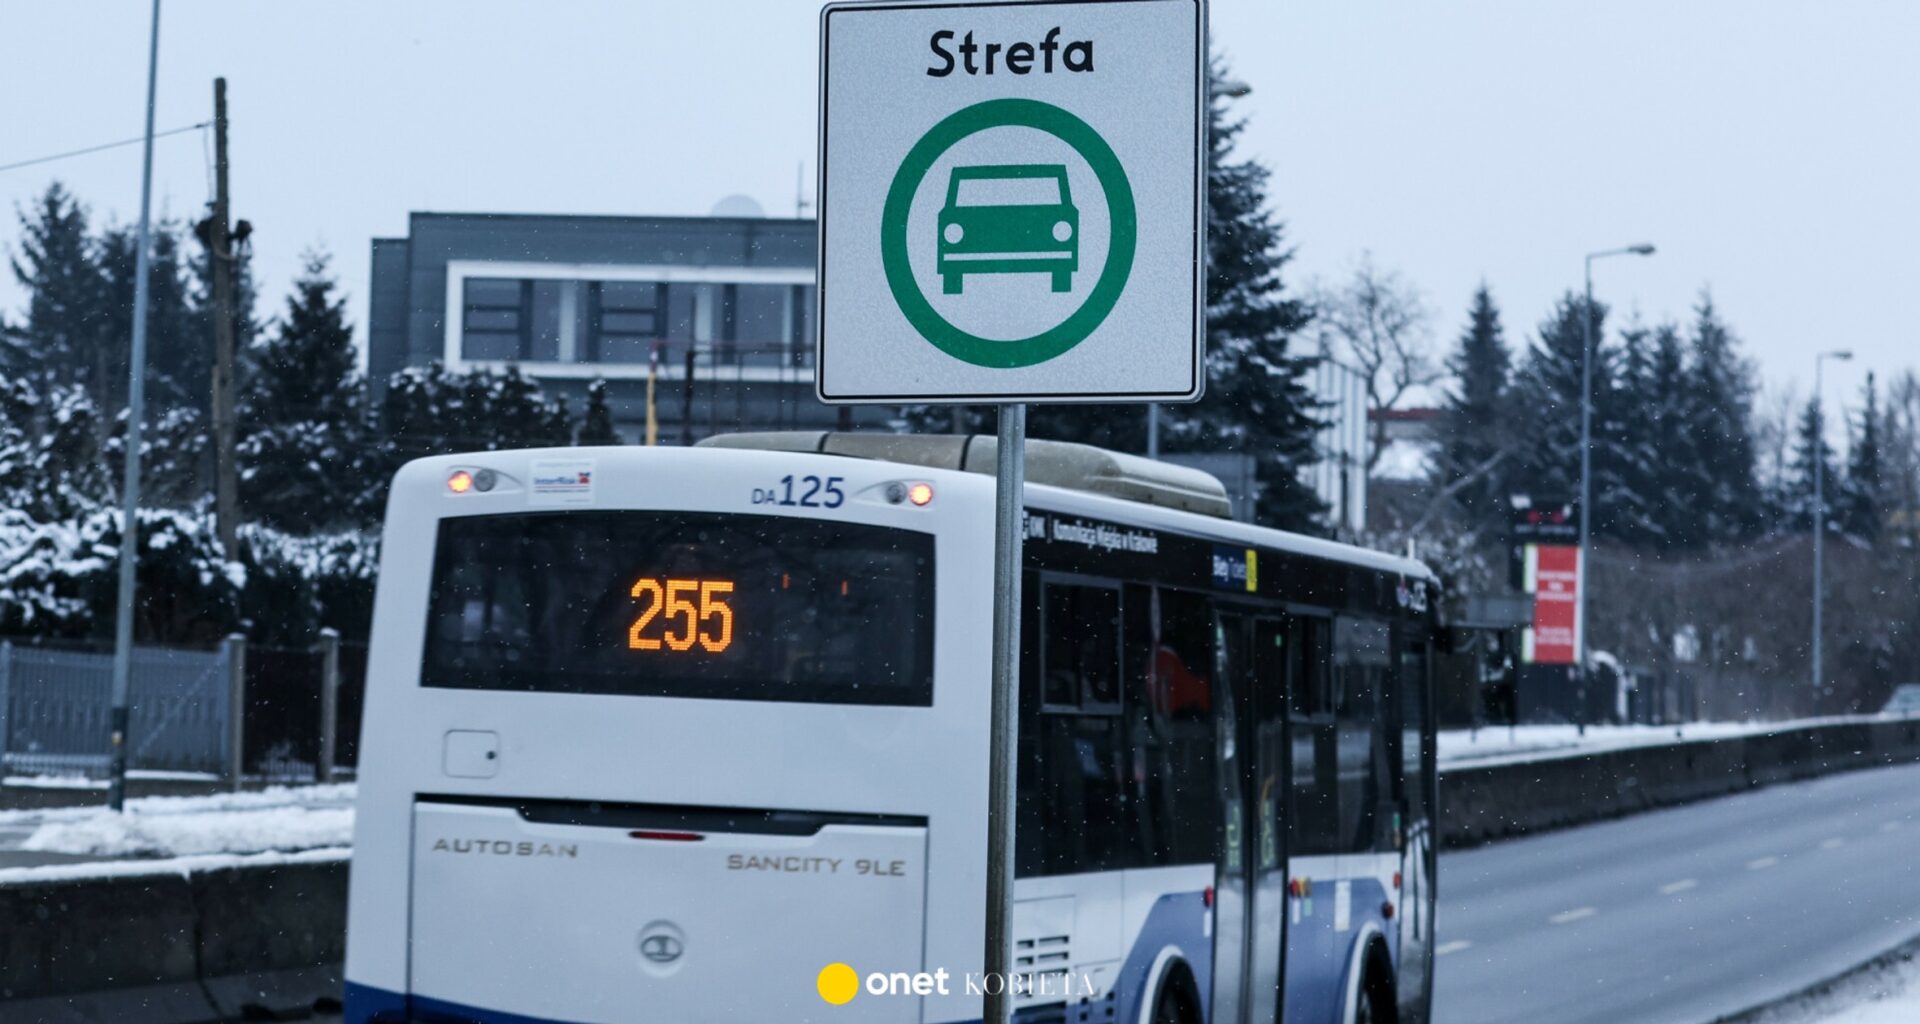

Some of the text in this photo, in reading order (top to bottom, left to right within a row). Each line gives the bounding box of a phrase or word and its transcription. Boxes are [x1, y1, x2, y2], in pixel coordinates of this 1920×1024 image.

[926, 26, 1095, 78] Strefa
[629, 578, 734, 652] 255
[432, 838, 578, 858] AUTOSAN
[727, 854, 906, 877] SANCITY 9LE
